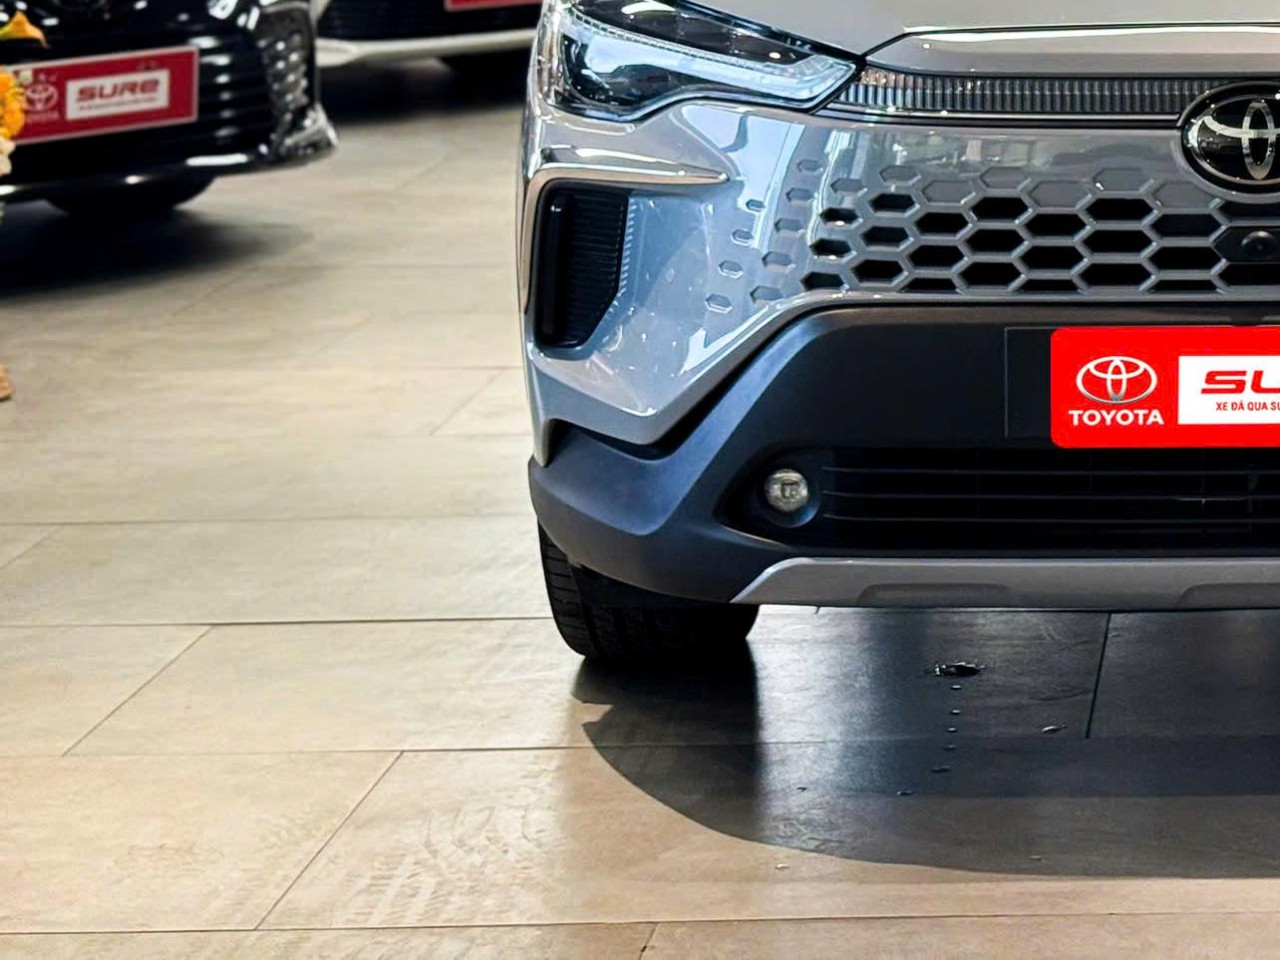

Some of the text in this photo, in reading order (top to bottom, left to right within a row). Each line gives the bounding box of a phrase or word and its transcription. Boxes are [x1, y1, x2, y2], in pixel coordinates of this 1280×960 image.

[77, 79, 160, 102] SURE
[1216, 401, 1228, 411] XE
[1247, 401, 1268, 411] QUA
[1068, 410, 1164, 426] TOYOTA
